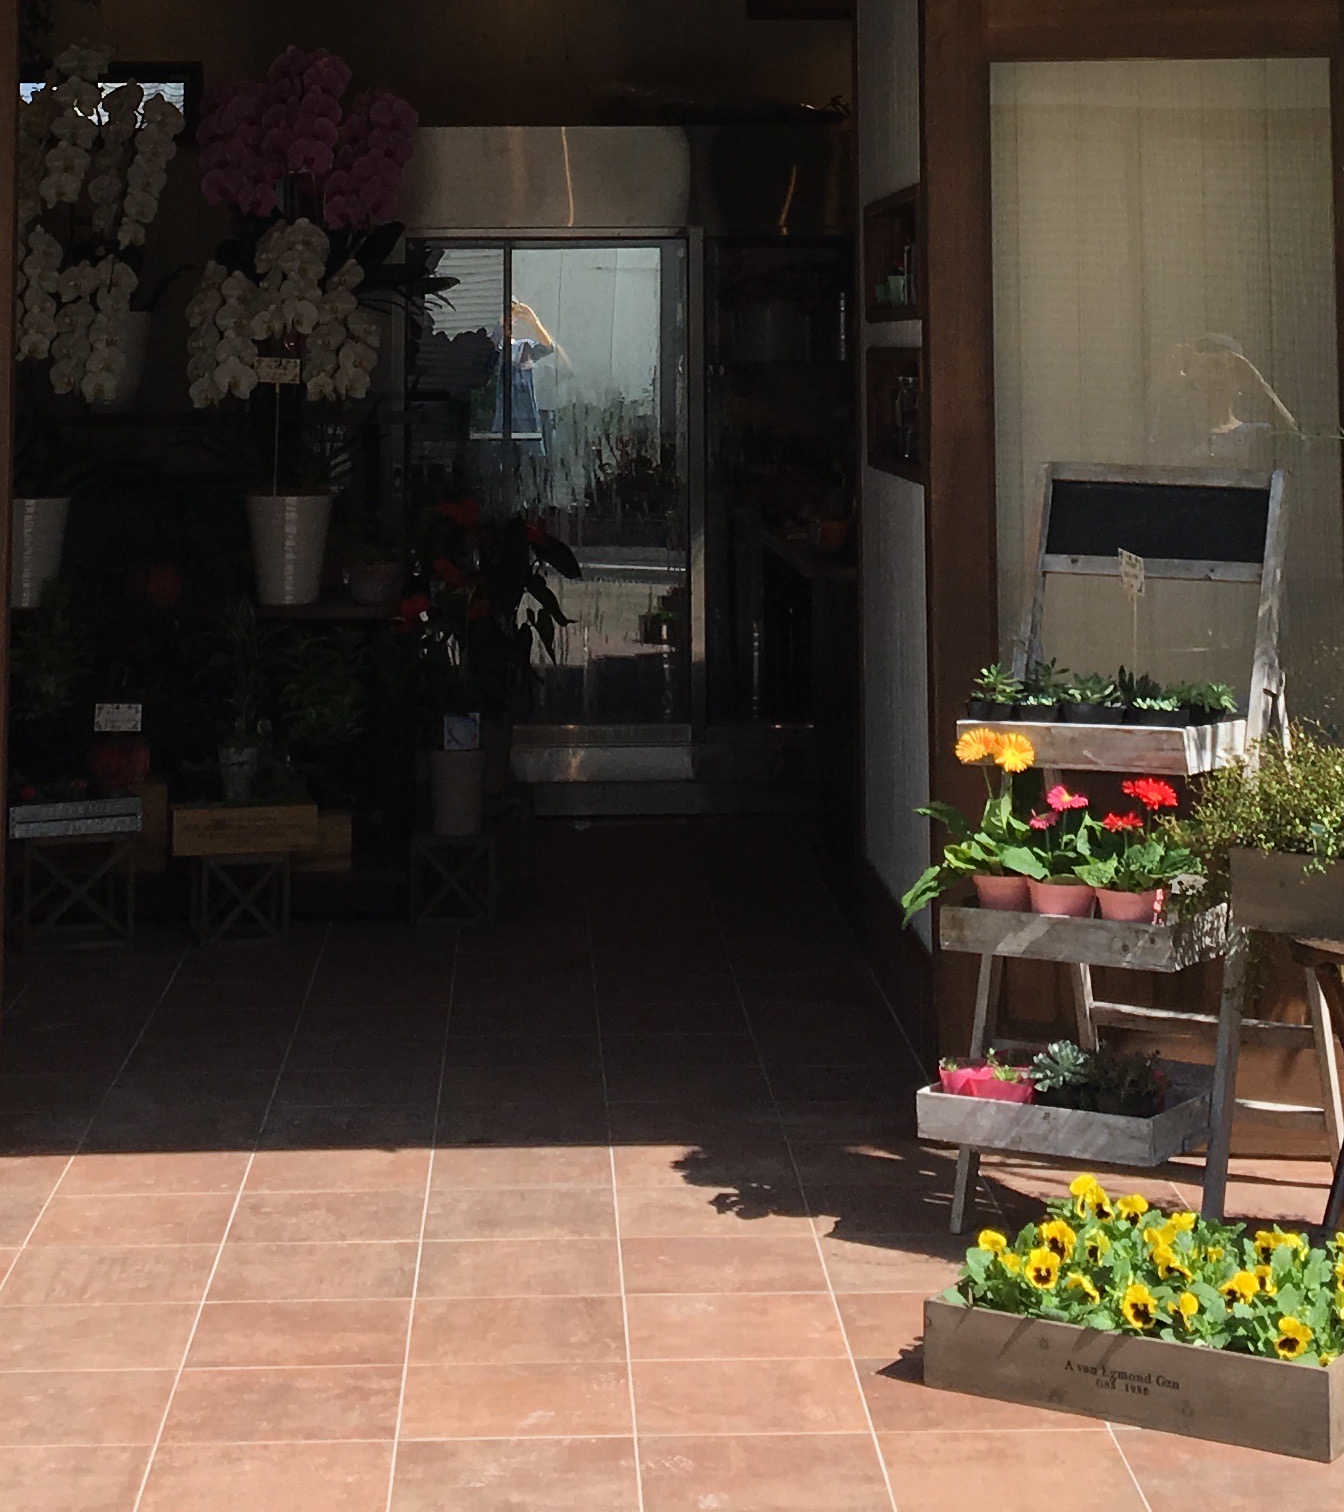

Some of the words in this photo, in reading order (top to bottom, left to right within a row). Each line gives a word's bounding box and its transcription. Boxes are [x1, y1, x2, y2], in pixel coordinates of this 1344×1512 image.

[1064, 1359, 1074, 1371] A
[1077, 1363, 1097, 1376] van
[1101, 1365, 1152, 1384] Egmond
